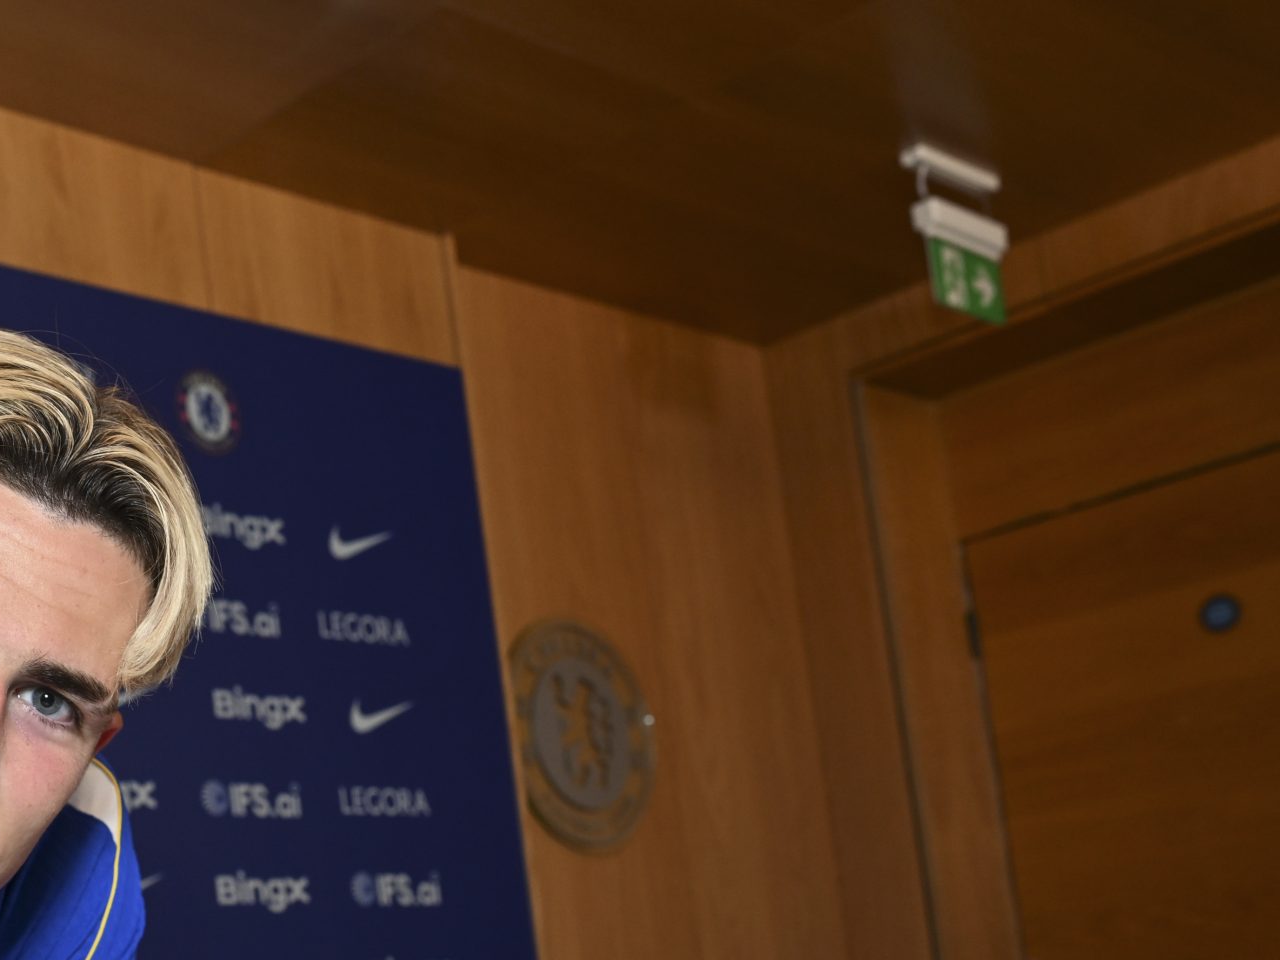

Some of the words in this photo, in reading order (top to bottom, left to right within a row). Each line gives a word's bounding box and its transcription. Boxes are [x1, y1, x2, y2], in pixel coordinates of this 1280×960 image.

[317, 610, 410, 645] LEGORA
[228, 780, 302, 818] IFS.ai
[338, 785, 431, 817] LEGORA
[374, 872, 442, 906] IFS.ai
